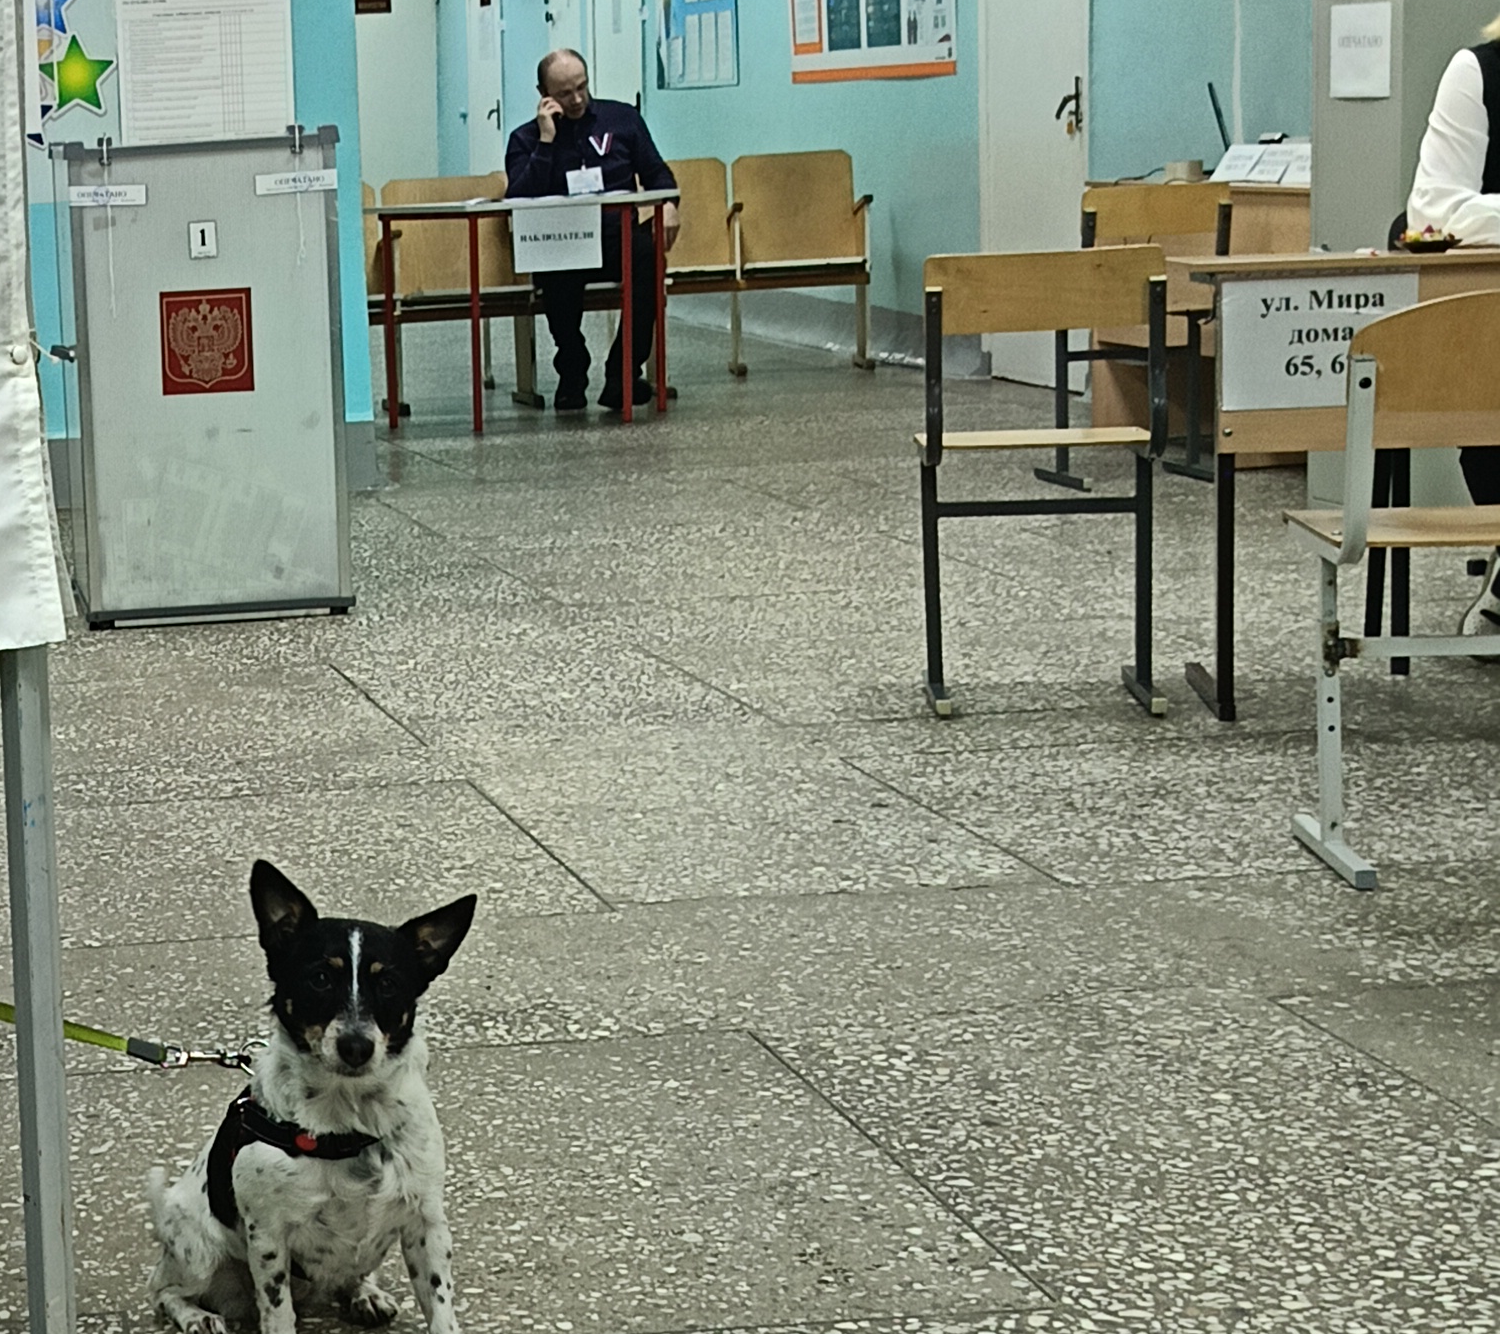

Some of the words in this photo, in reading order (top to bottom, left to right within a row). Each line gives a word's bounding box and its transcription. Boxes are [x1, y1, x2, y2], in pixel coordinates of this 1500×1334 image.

[199, 228, 207, 247] 1
[1260, 296, 1300, 319] ул.
[1308, 289, 1385, 315] Мира
[1288, 326, 1355, 346] дома
[1284, 354, 1323, 379] 65,
[1330, 353, 1346, 375] 6
